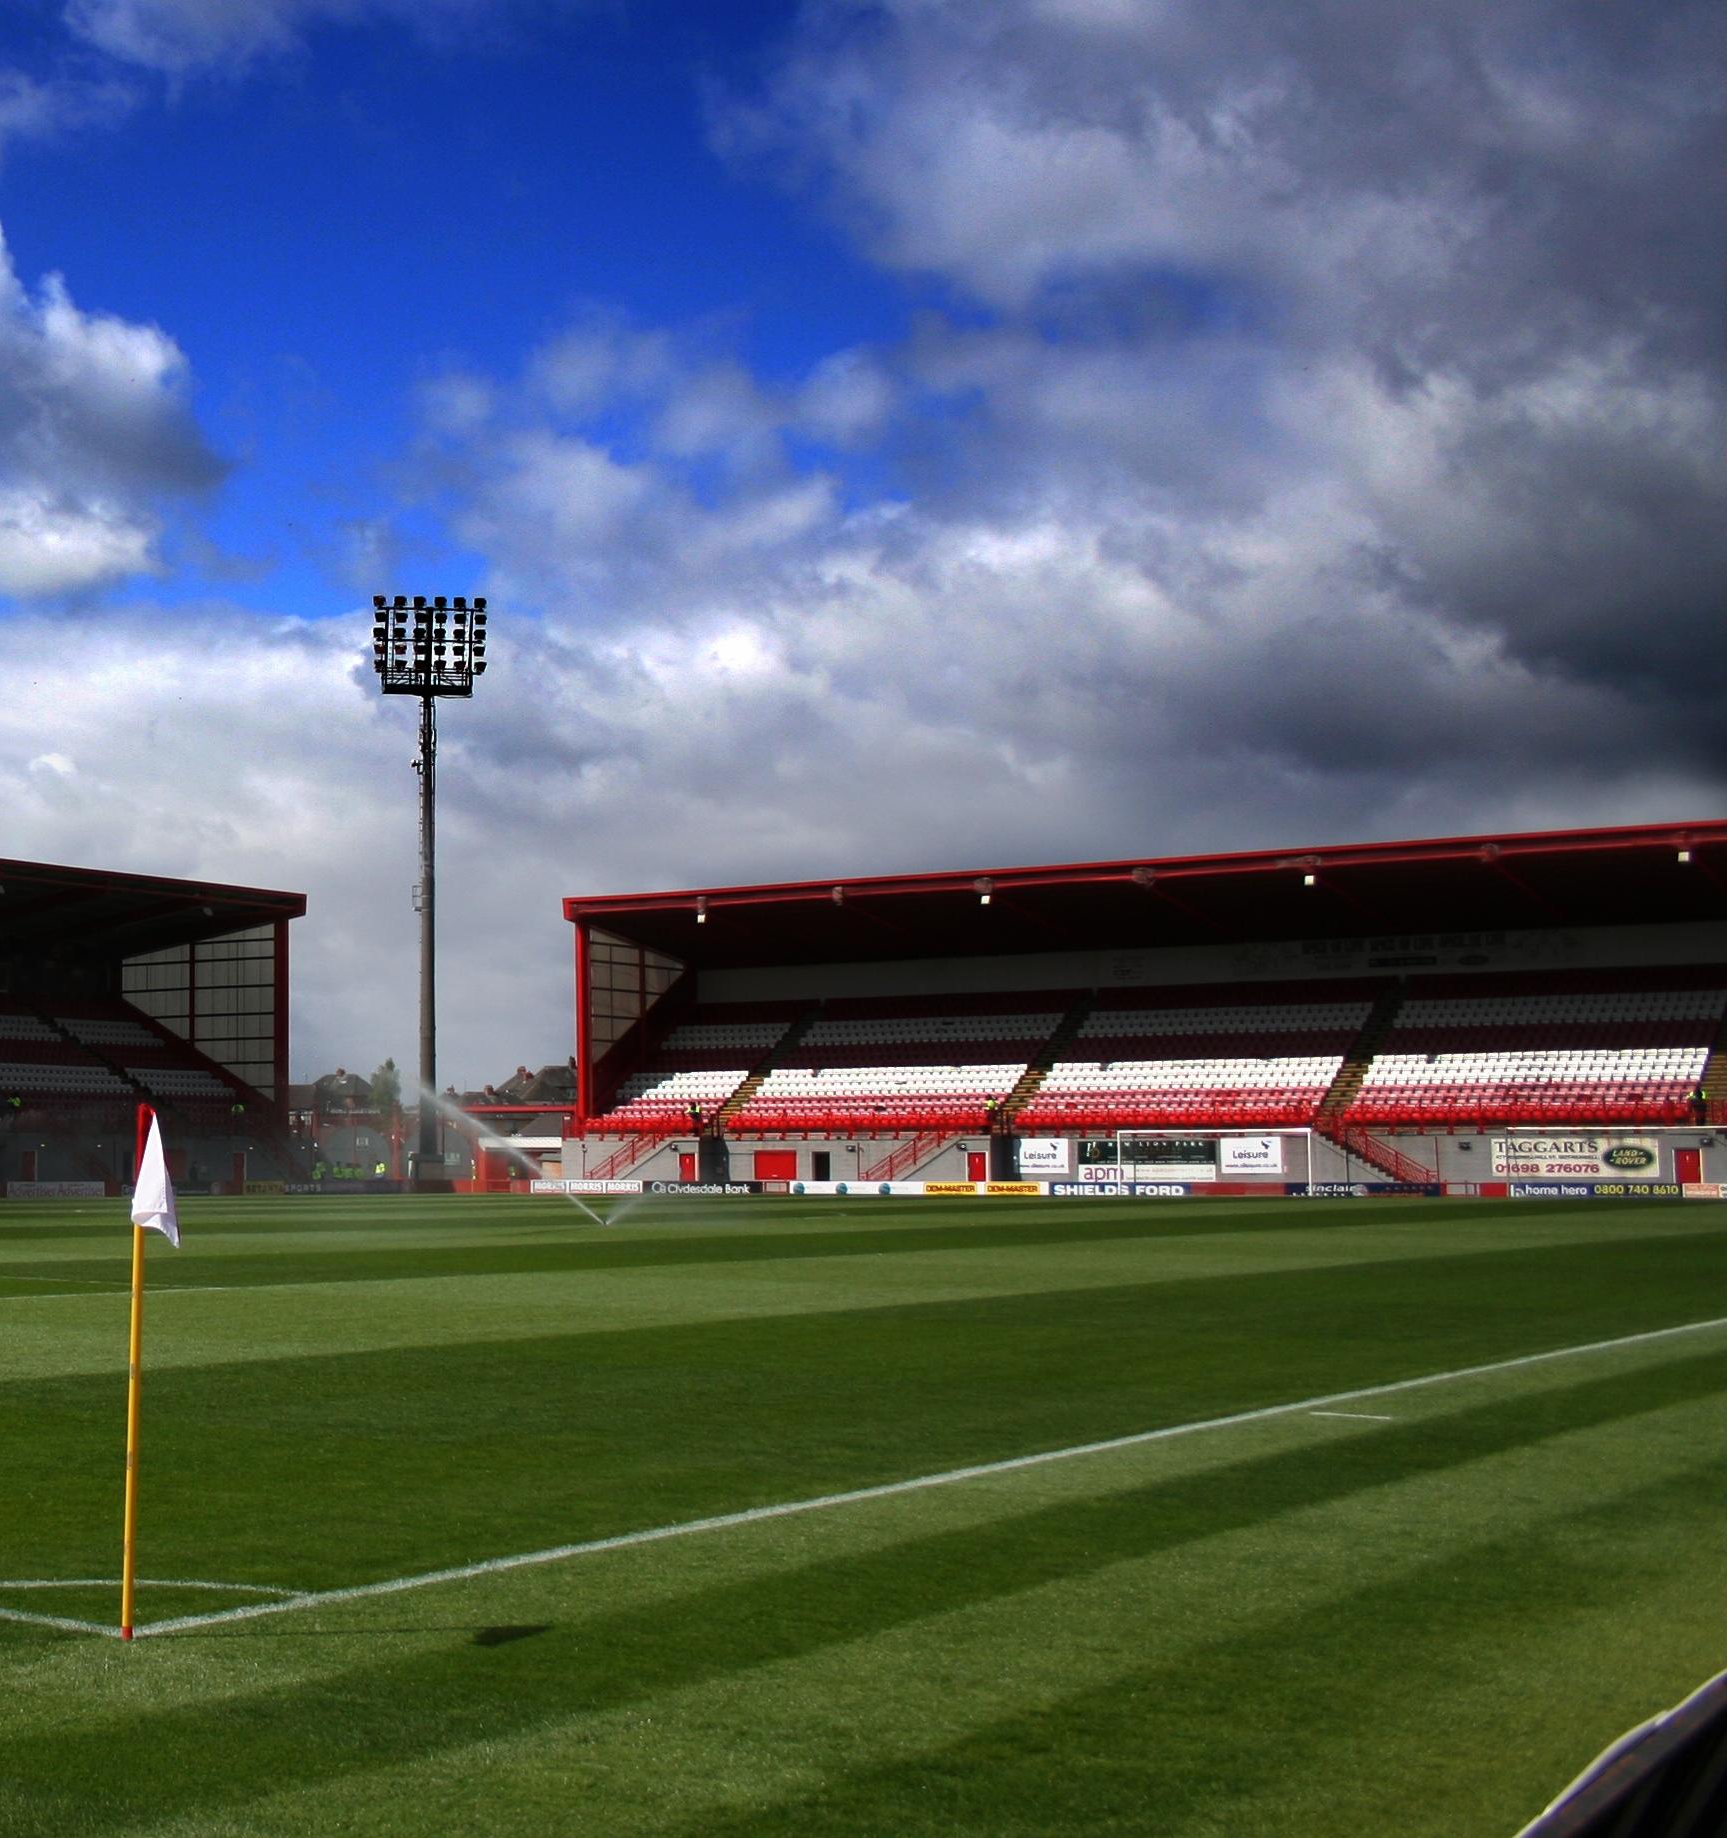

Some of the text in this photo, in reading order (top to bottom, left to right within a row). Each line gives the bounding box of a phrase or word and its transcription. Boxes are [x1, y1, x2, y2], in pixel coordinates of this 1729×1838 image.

[1494, 1141, 1599, 1153] TAGGARTS
[1023, 1151, 1057, 1160] Leisure
[1232, 1150, 1269, 1159] Leisure
[1495, 1163, 1600, 1173] 01698 276076
[1084, 1167, 1125, 1182] apm
[667, 1183, 751, 1194] Clydesdale Bank
[1053, 1184, 1184, 1196] SHIELDS FORD
[1305, 1183, 1355, 1192] sinclair
[1525, 1185, 1558, 1196] home
[1561, 1185, 1588, 1196] hero
[1594, 1184, 1625, 1195] 0800
[1628, 1184, 1649, 1195] 740
[1652, 1184, 1679, 1195] 8610
